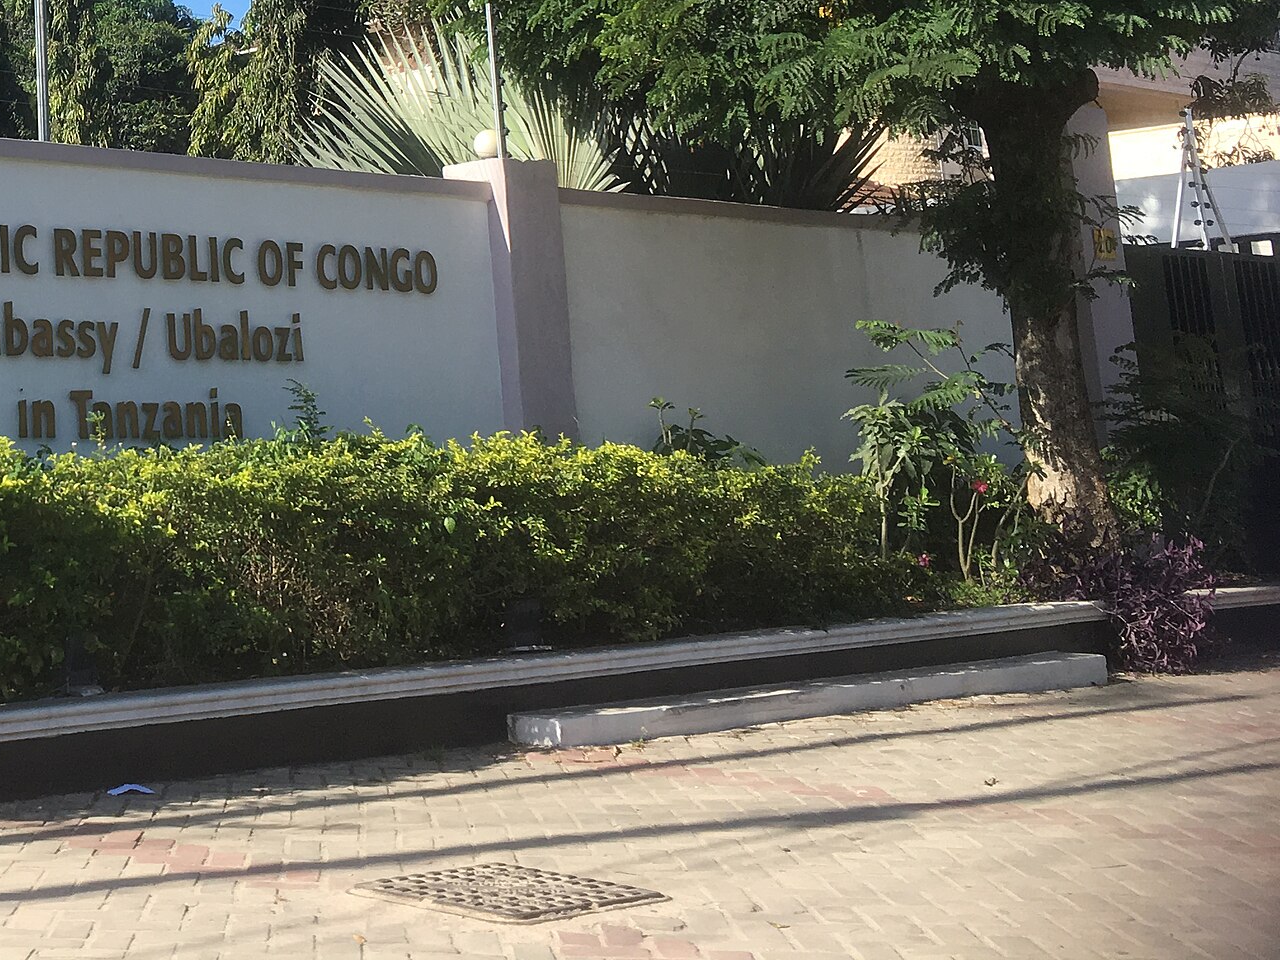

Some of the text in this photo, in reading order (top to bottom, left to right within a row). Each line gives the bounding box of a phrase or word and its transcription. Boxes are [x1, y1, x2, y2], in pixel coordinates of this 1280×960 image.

[53, 227, 245, 285] REPUBLIC
[257, 239, 304, 287] OF
[316, 243, 439, 295] CONGO
[132, 307, 151, 369] /
[166, 307, 304, 362] Ubalozi
[18, 387, 244, 440] in Tanzania
